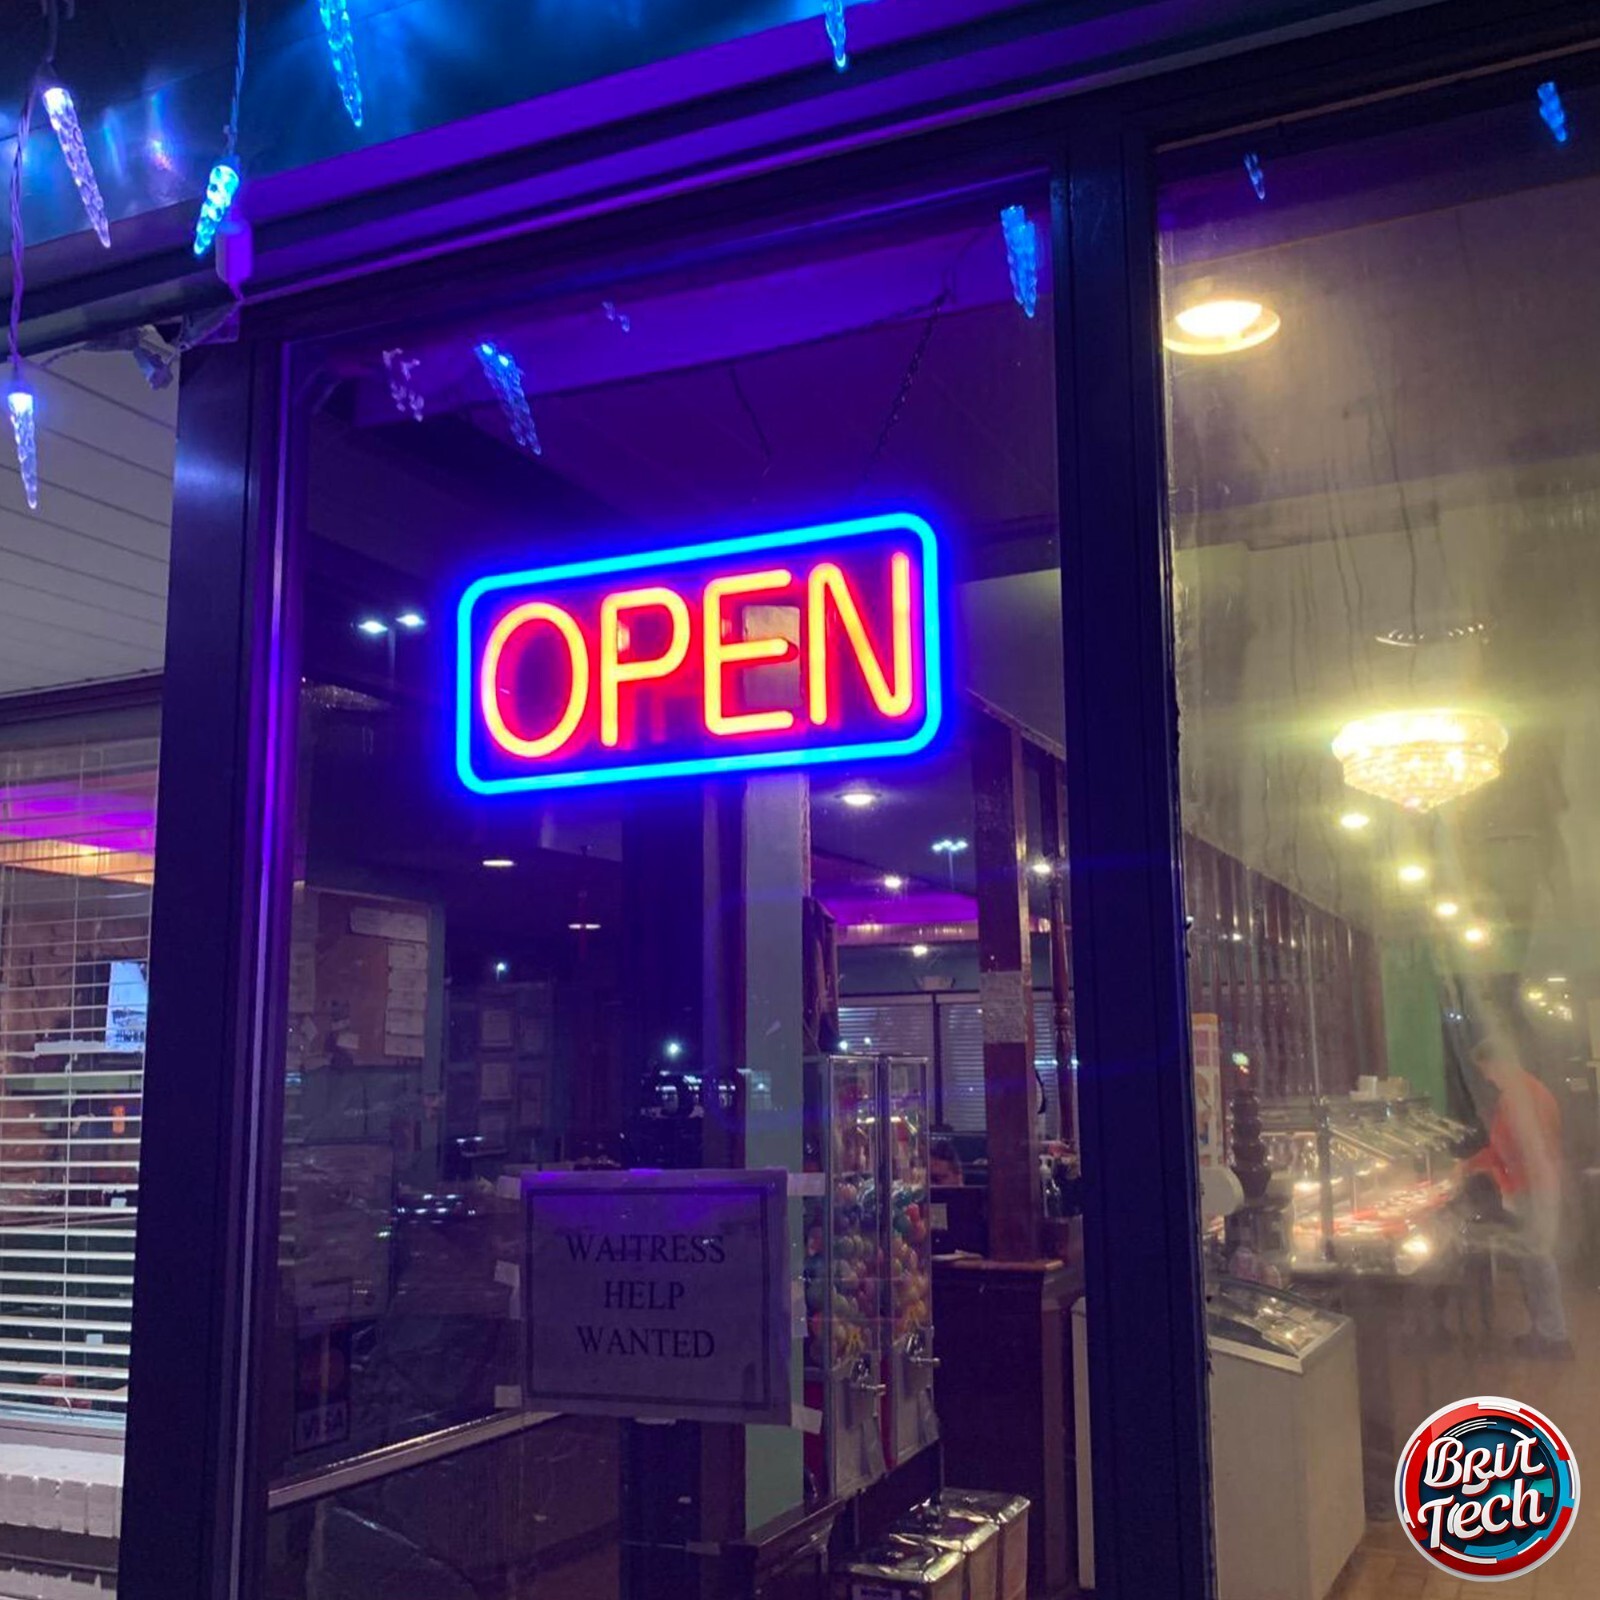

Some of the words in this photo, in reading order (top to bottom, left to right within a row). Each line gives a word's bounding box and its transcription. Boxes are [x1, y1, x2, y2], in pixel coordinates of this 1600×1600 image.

[481, 551, 914, 759] OPEN
[566, 1234, 727, 1265] WAITRESS
[603, 1280, 686, 1311] HELP
[575, 1324, 716, 1360] WANTED
